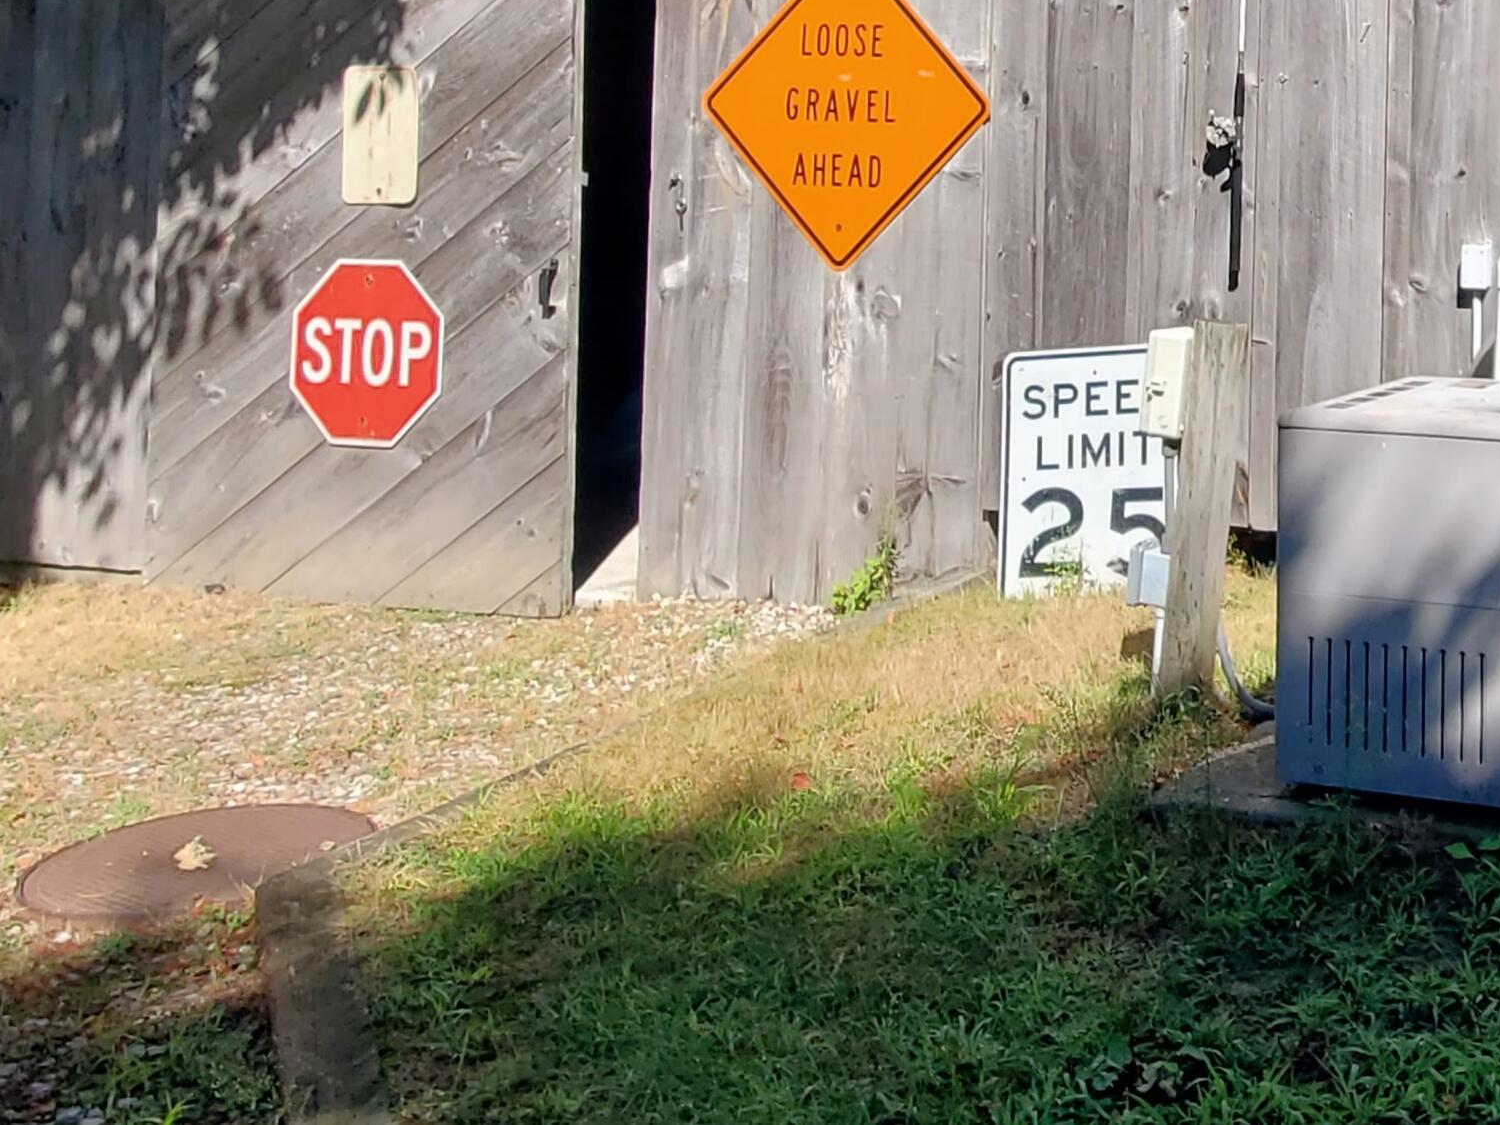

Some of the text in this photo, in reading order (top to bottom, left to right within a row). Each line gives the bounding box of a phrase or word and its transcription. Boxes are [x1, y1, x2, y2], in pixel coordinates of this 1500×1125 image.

[801, 23, 884, 58] LOOSE
[786, 87, 895, 123] GRAVEL
[792, 152, 882, 188] AHEAD
[302, 316, 432, 388] STOP
[1022, 379, 1140, 420] SPEE
[1036, 431, 1149, 471] LIMIT
